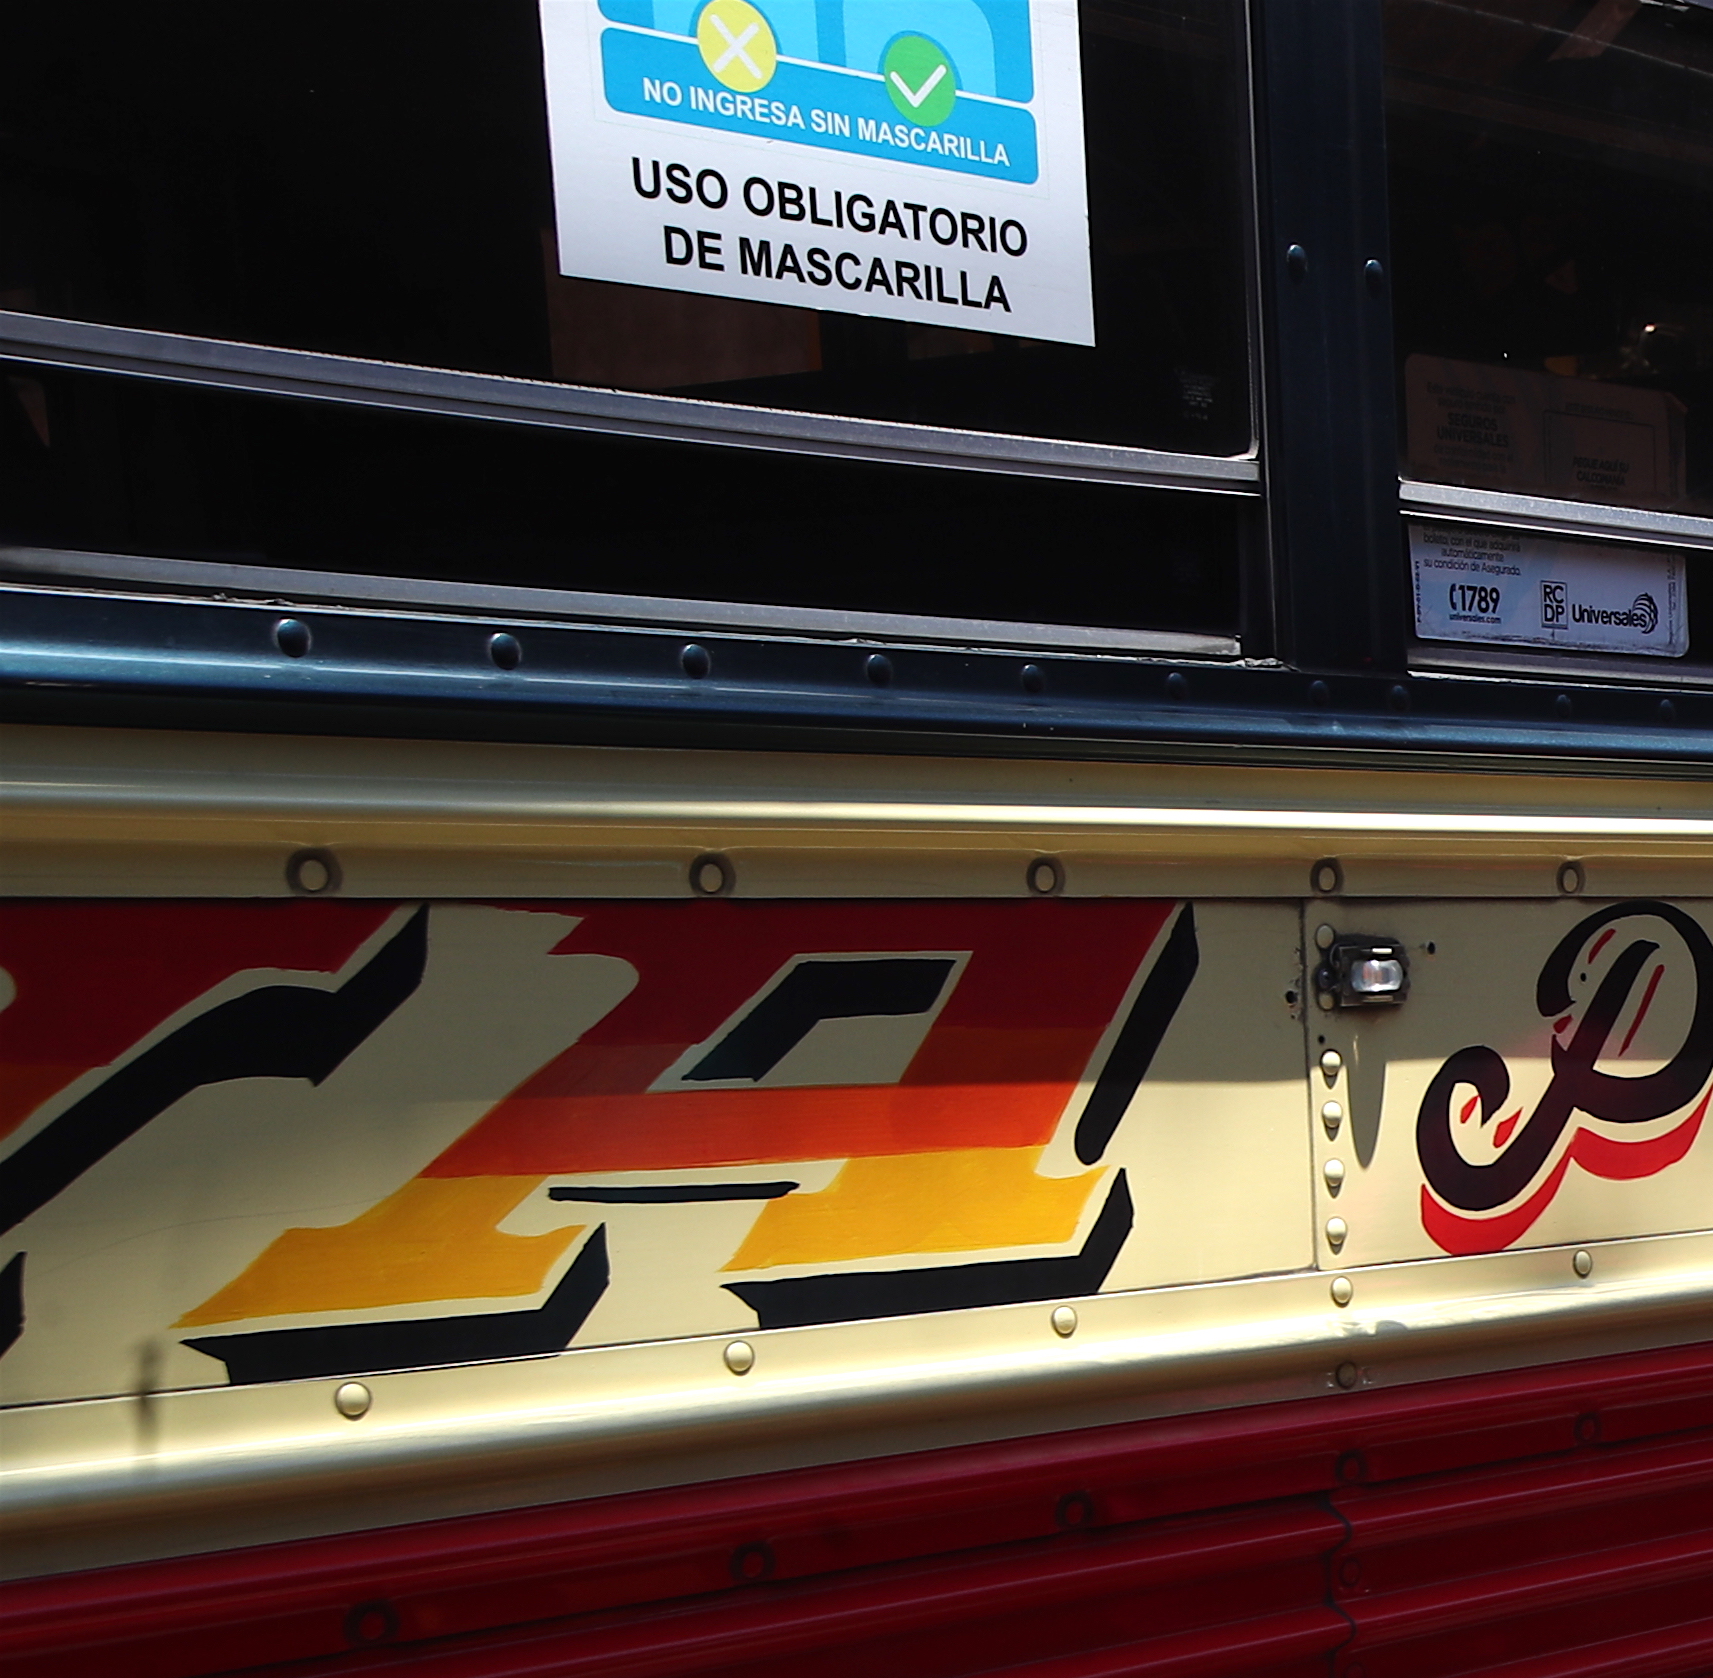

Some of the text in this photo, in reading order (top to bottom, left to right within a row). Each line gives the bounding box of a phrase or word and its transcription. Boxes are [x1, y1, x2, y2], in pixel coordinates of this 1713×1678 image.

[642, 77, 1011, 167] NO INGRESA SIN MASCARILLA
[632, 156, 1029, 258] USO OBLIGATORIO
[663, 225, 1012, 313] DE MASCARILLA
[1447, 412, 1498, 432] SEGUROS
[1437, 425, 1509, 448] UNIVERSALES
[1458, 584, 1501, 614] 1789
[1543, 584, 1565, 604] RC
[1544, 604, 1565, 623] DP
[1571, 603, 1648, 628] Universales
